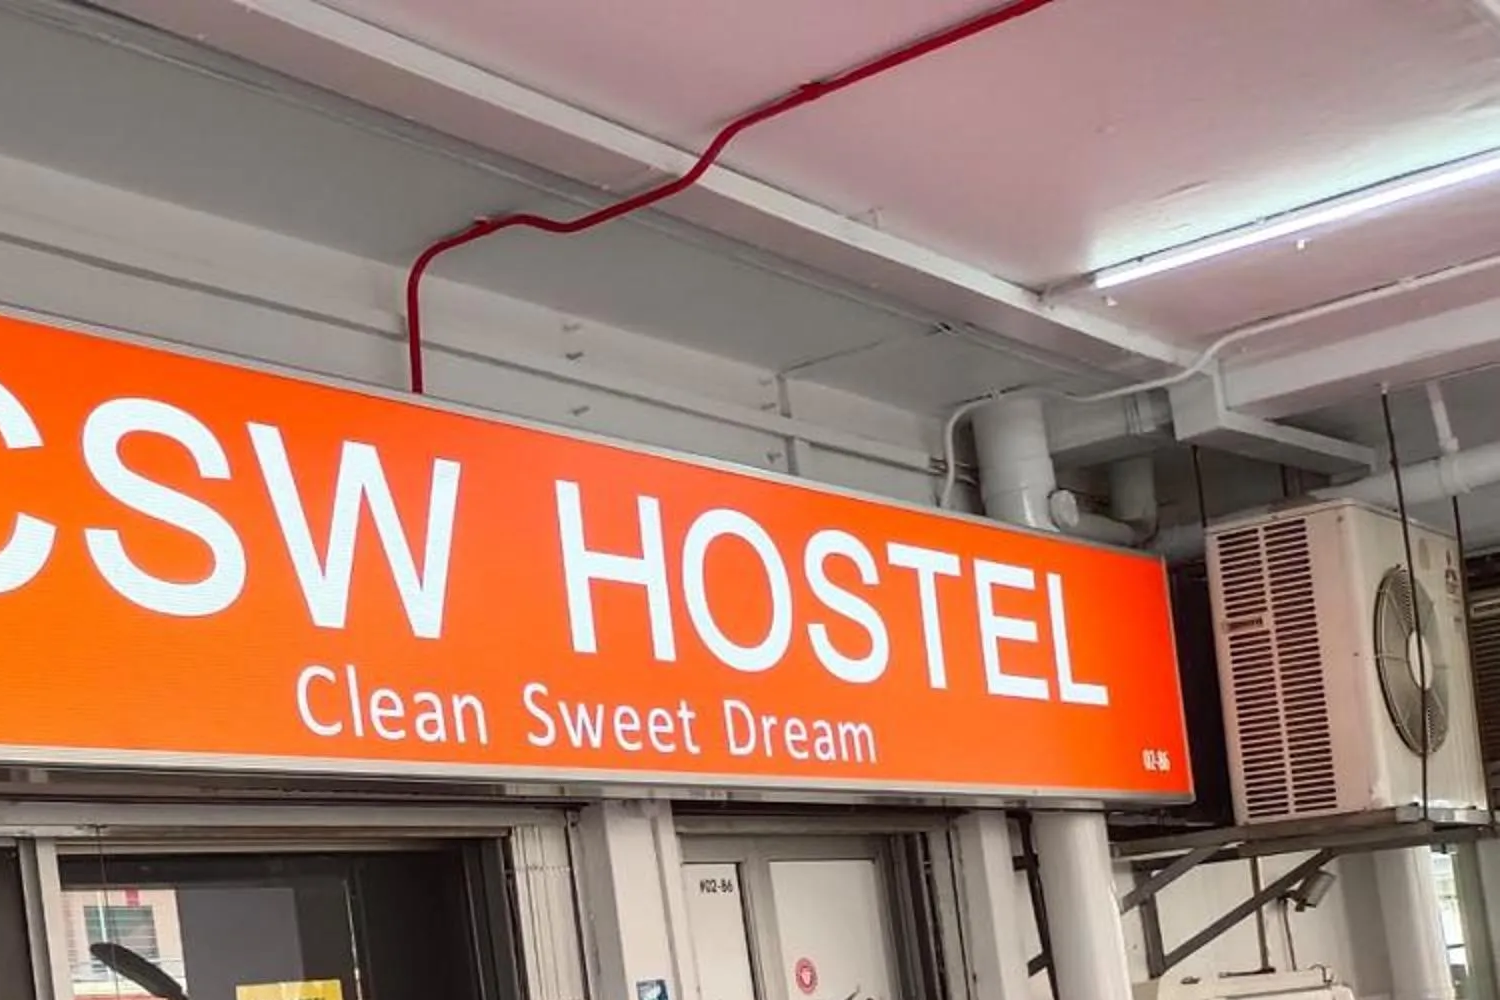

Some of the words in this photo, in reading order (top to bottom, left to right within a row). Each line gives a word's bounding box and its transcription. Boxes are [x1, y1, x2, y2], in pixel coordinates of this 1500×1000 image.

[555, 480, 1109, 705] HOSTEL
[296, 664, 488, 744] Clean
[522, 683, 701, 754] Sweet
[723, 701, 877, 764] Dream
